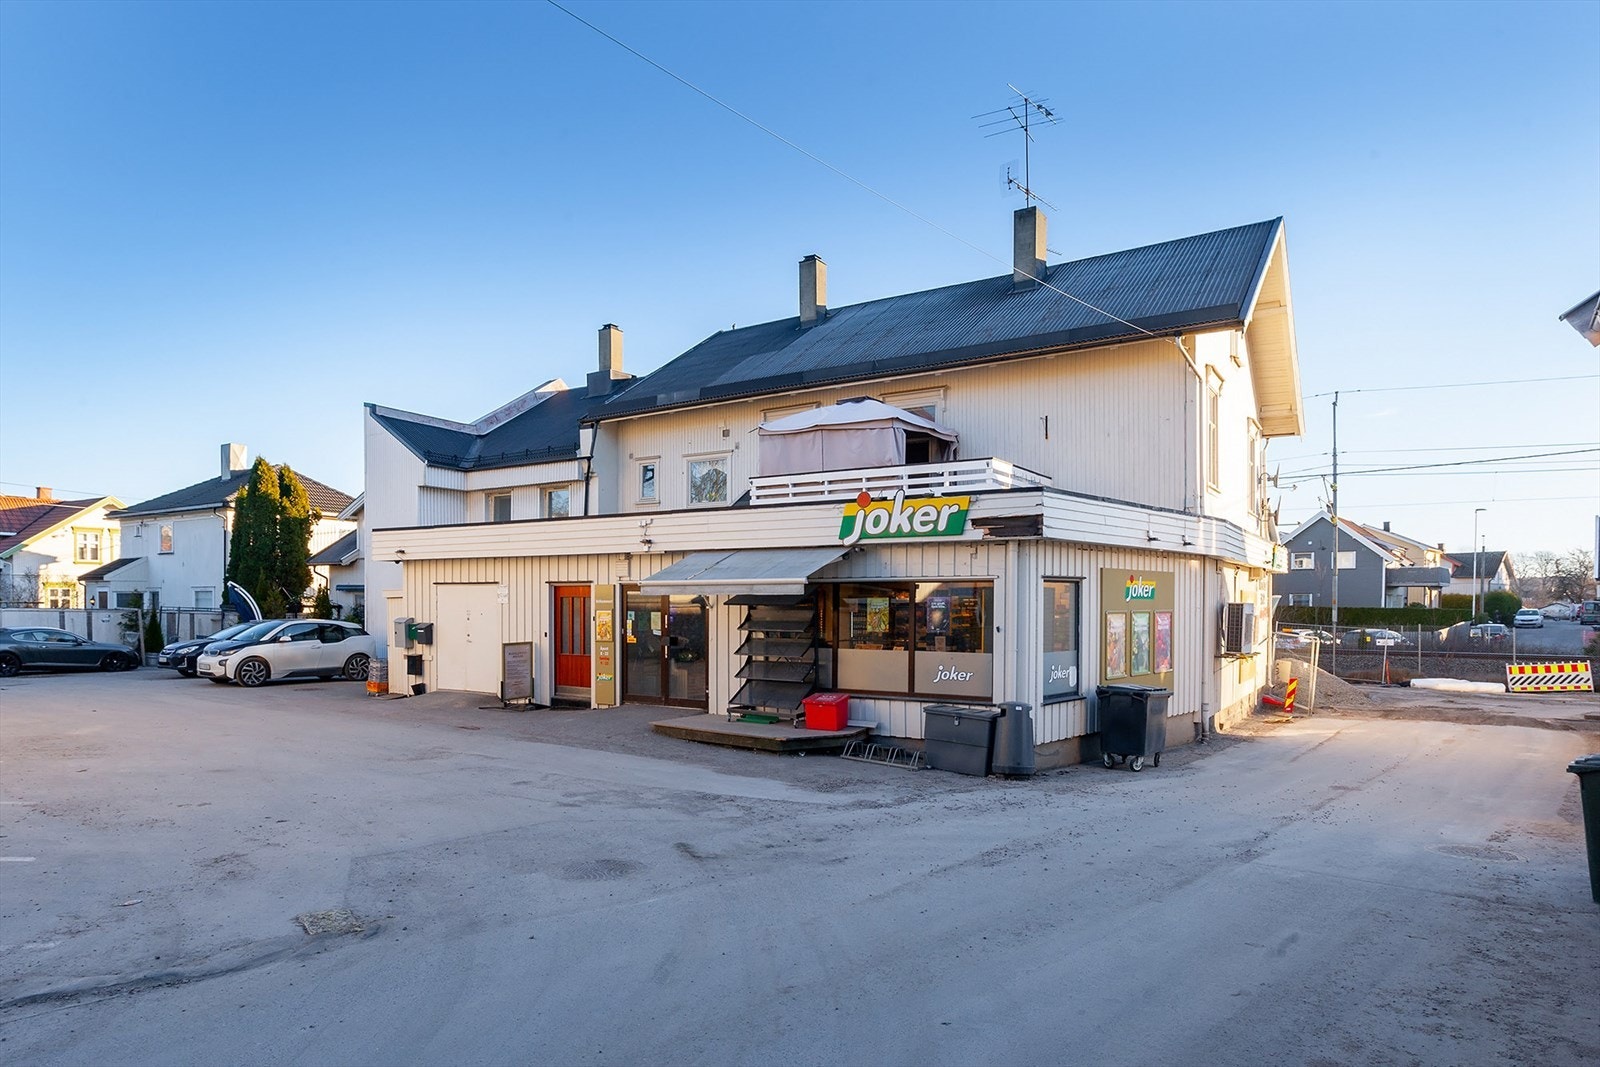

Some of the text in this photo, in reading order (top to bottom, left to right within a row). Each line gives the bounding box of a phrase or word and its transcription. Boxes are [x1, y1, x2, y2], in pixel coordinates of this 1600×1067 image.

[843, 489, 960, 546] joker
[1126, 575, 1154, 602] joker
[933, 665, 973, 682] joker
[1049, 664, 1071, 683] joker
